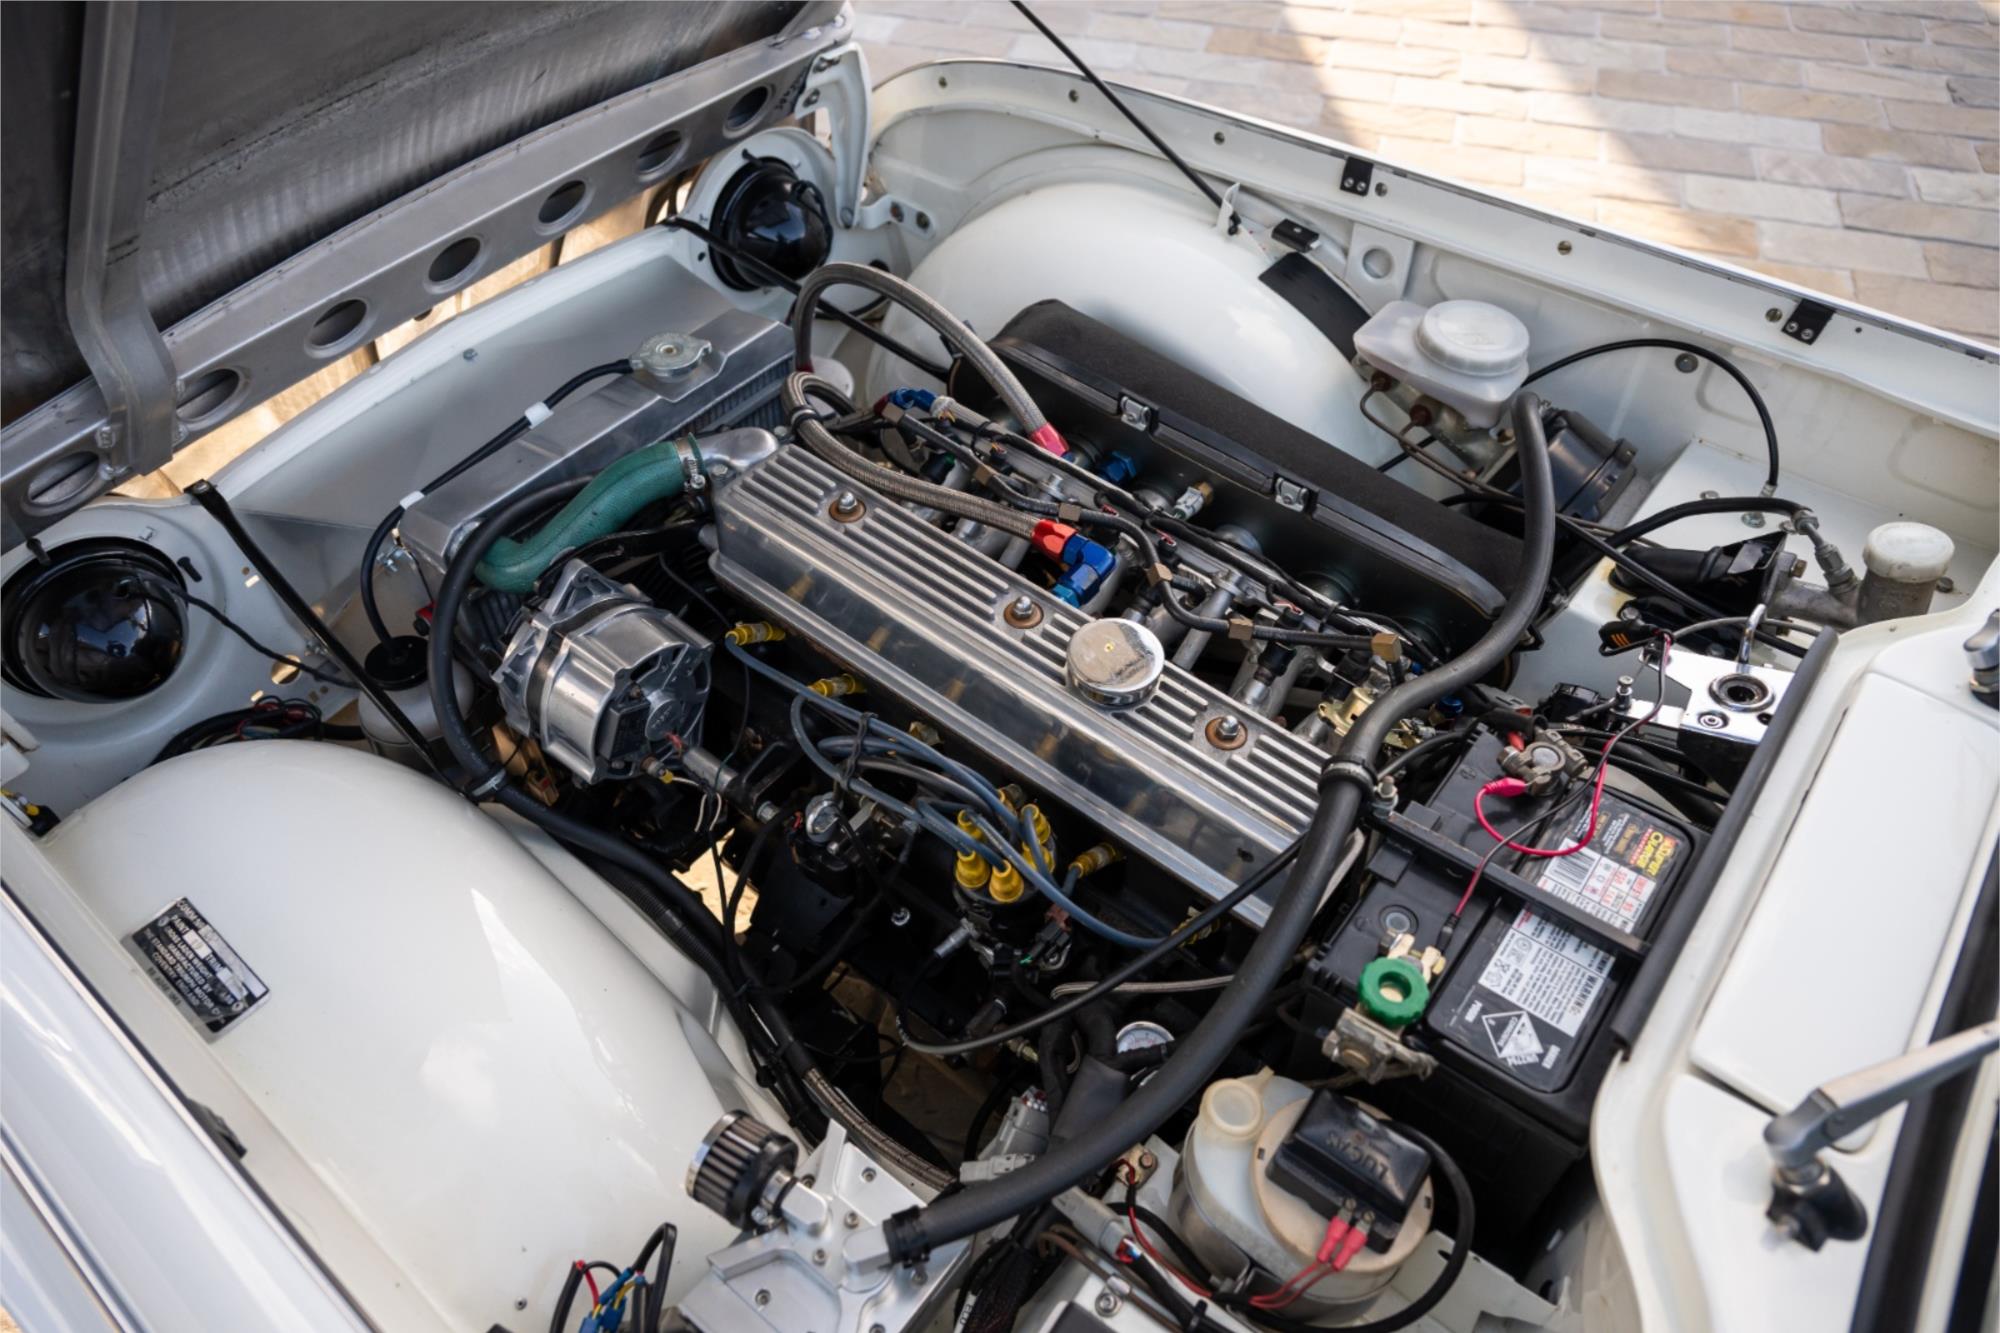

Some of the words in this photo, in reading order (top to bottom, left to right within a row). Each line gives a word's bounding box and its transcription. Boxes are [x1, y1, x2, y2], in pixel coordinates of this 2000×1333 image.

[166, 942, 205, 985] MANUFACTURED
[201, 982, 213, 994] BY
[169, 914, 189, 934] PAINT
[204, 953, 223, 973] TRIM
[177, 941, 195, 959] LADEN
[191, 957, 212, 979] WEIGHT
[150, 937, 177, 965] STANDARD
[172, 962, 197, 988] TRIUMPH
[193, 985, 215, 1009] MOTOR
[1323, 1131, 1389, 1180] LUCAS
